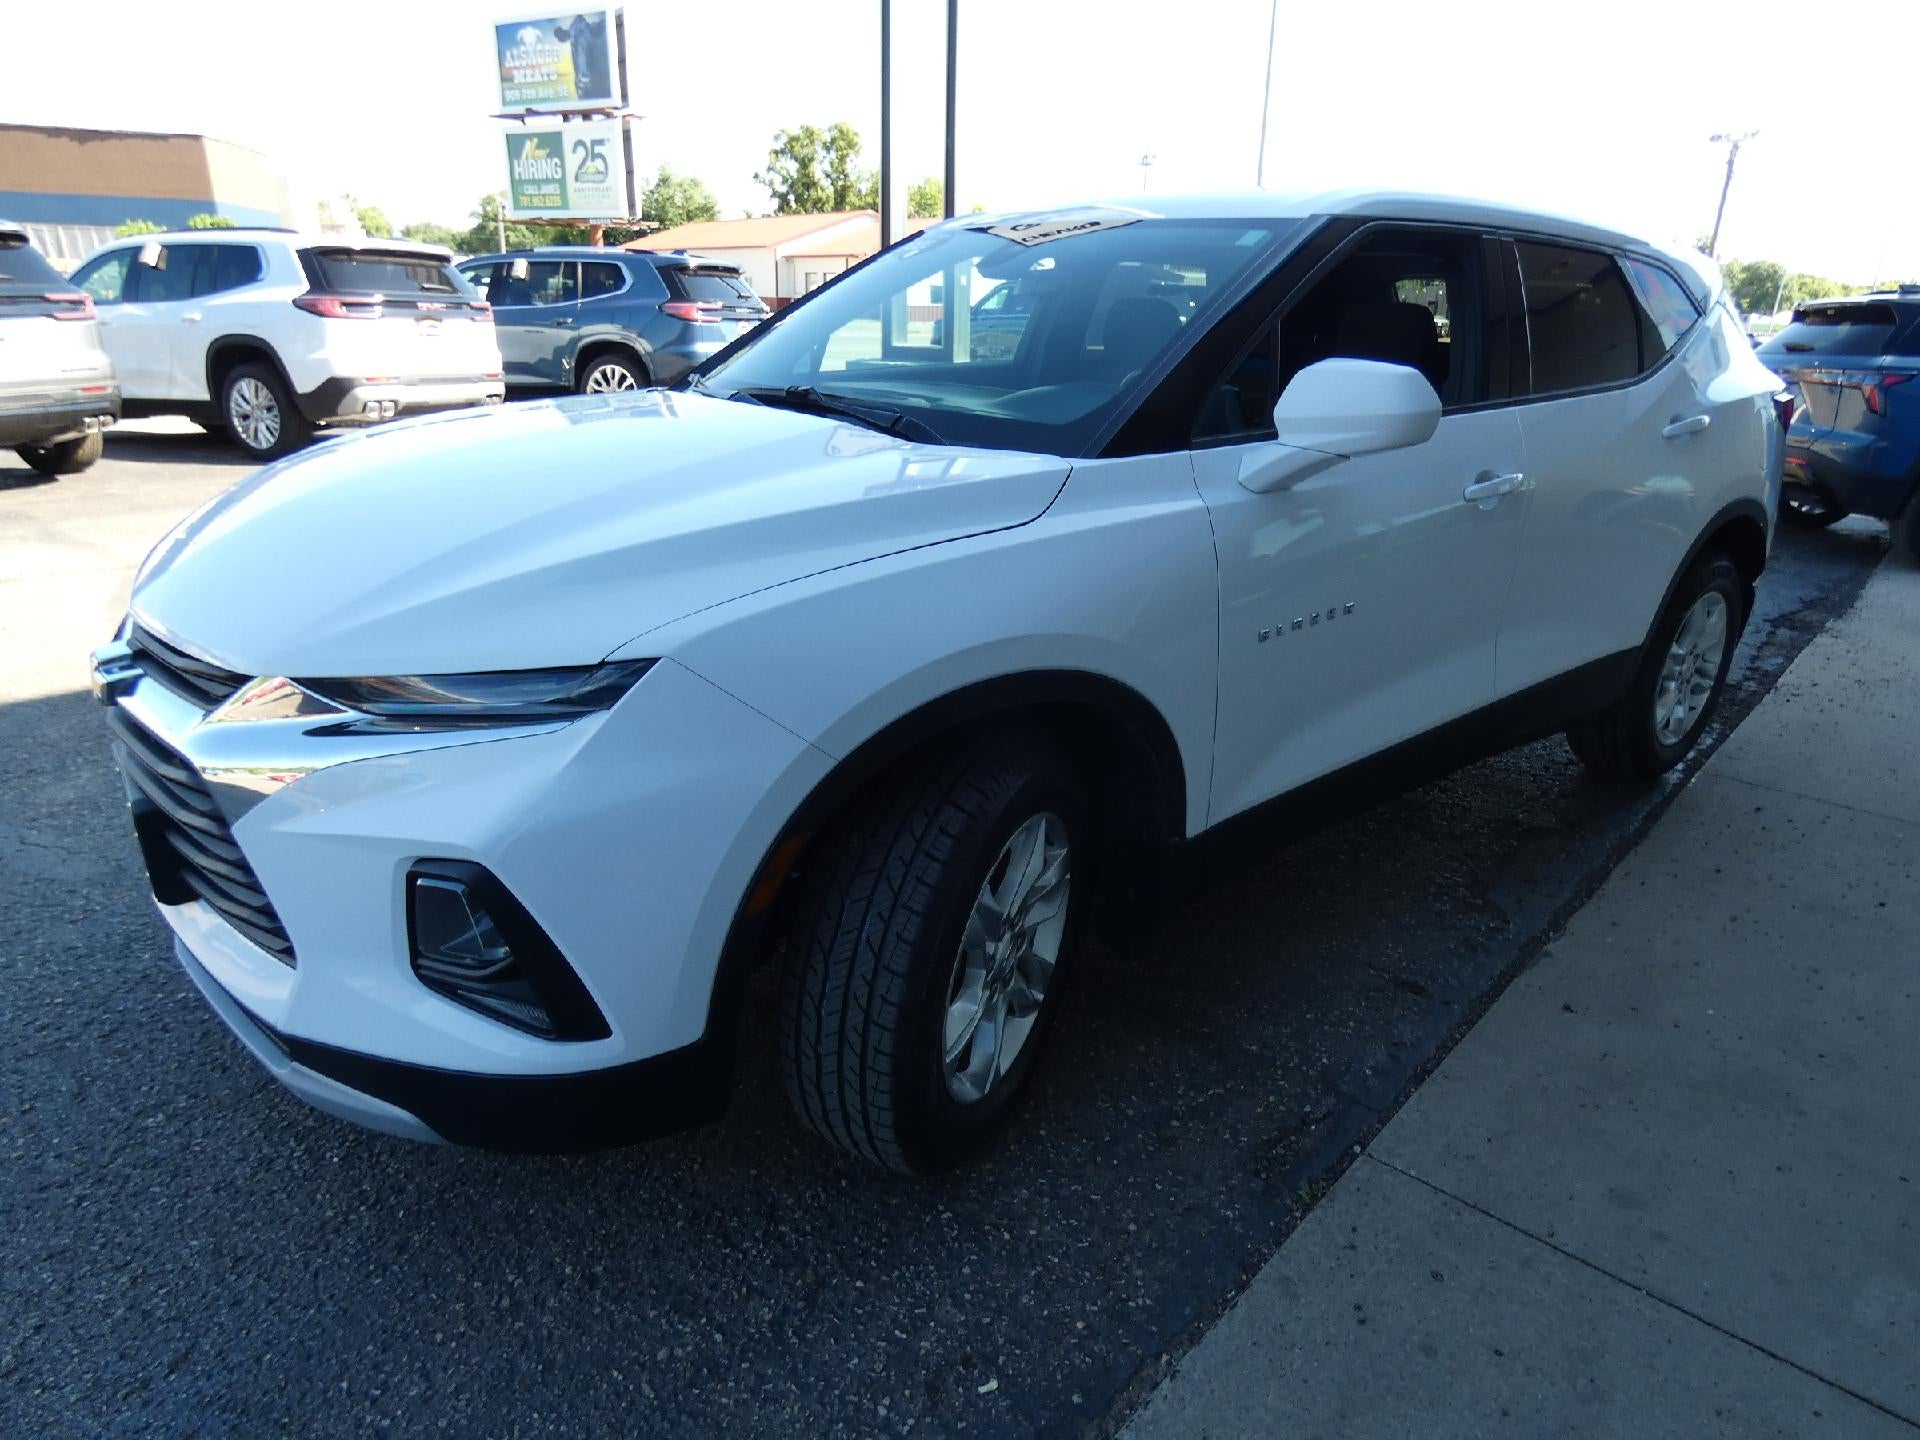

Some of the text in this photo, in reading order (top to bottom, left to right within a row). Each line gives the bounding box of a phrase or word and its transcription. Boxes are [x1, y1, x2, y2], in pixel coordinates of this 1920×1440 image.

[513, 67, 557, 83] MEATS
[558, 85, 569, 97] SE
[513, 158, 562, 180] HIRING
